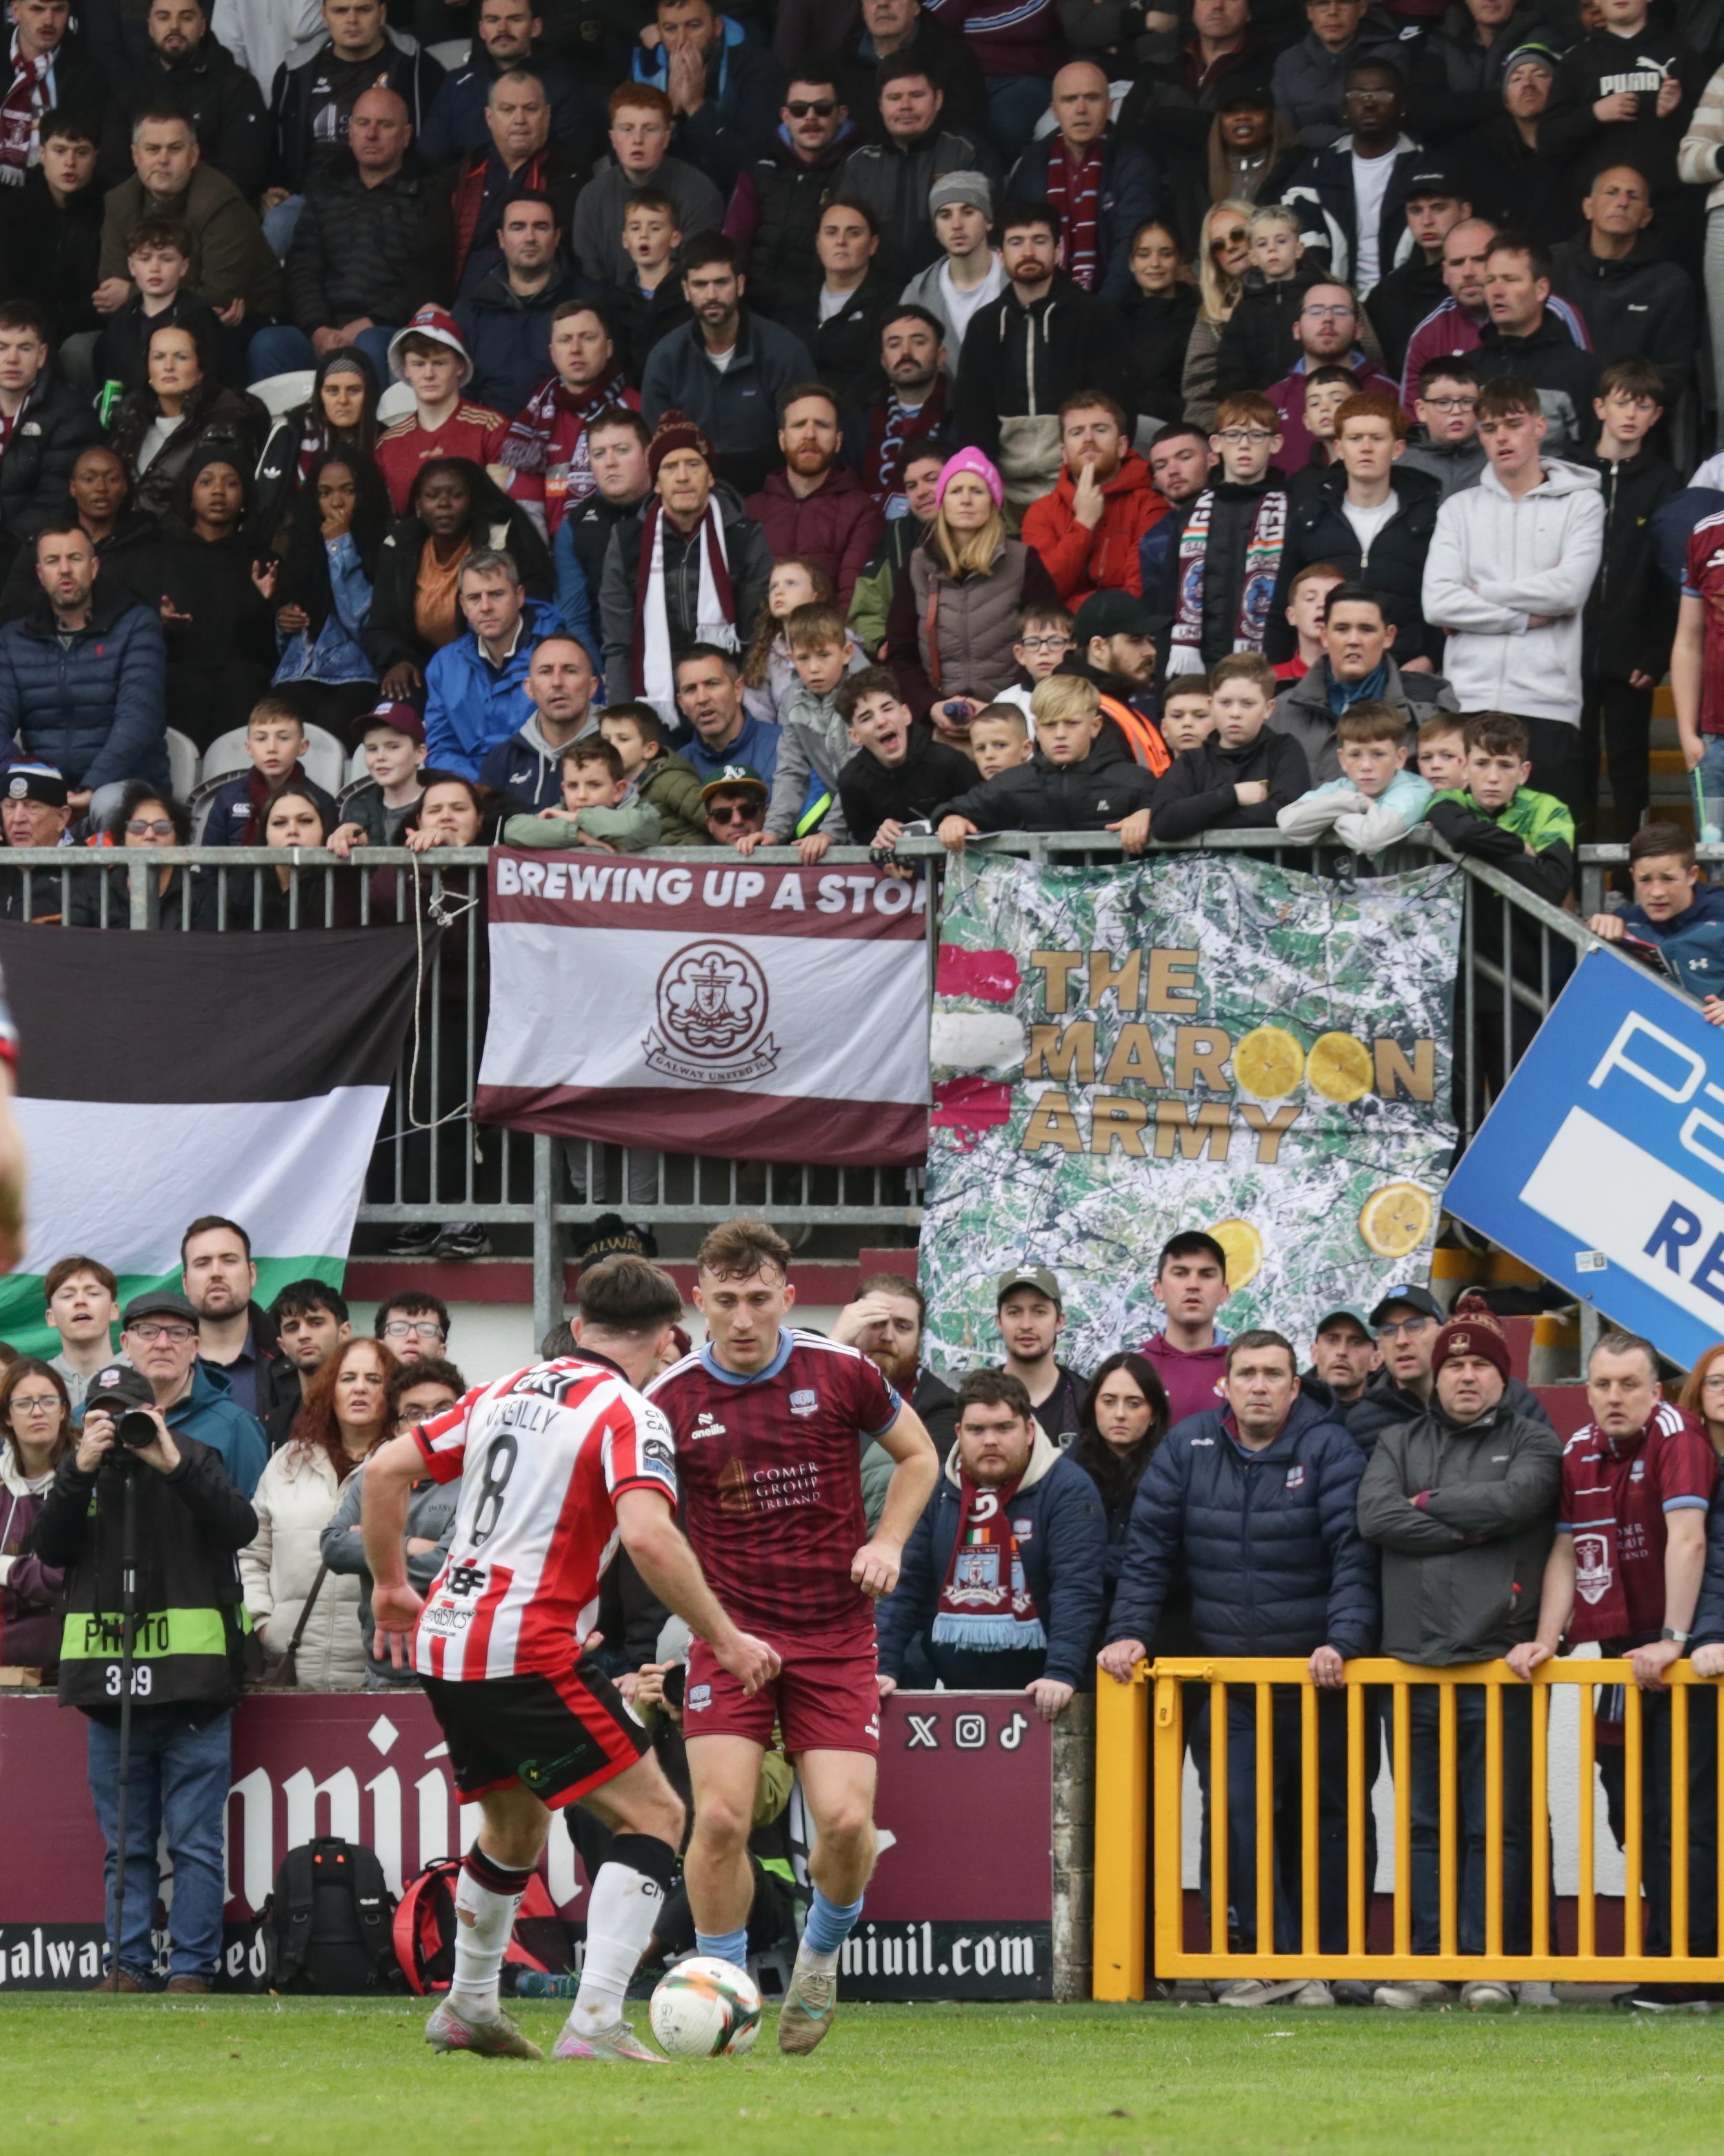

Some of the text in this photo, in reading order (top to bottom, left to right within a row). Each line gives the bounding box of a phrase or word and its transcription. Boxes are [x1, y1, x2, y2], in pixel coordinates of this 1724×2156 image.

[1599, 72, 1660, 96] PUMA
[497, 857, 693, 906] BREWING
[703, 870, 765, 908] UP
[770, 872, 805, 911] A
[1030, 948, 1199, 1015] THE
[656, 1057, 704, 1079] GALWAY
[1021, 1091, 1303, 1164] ARMY
[691, 1423, 726, 1440] oneills
[753, 1461, 819, 1483] COMER
[470, 1434, 518, 1547] 8
[756, 1476, 818, 1497] GROUP
[760, 1491, 821, 1510] IRELAND
